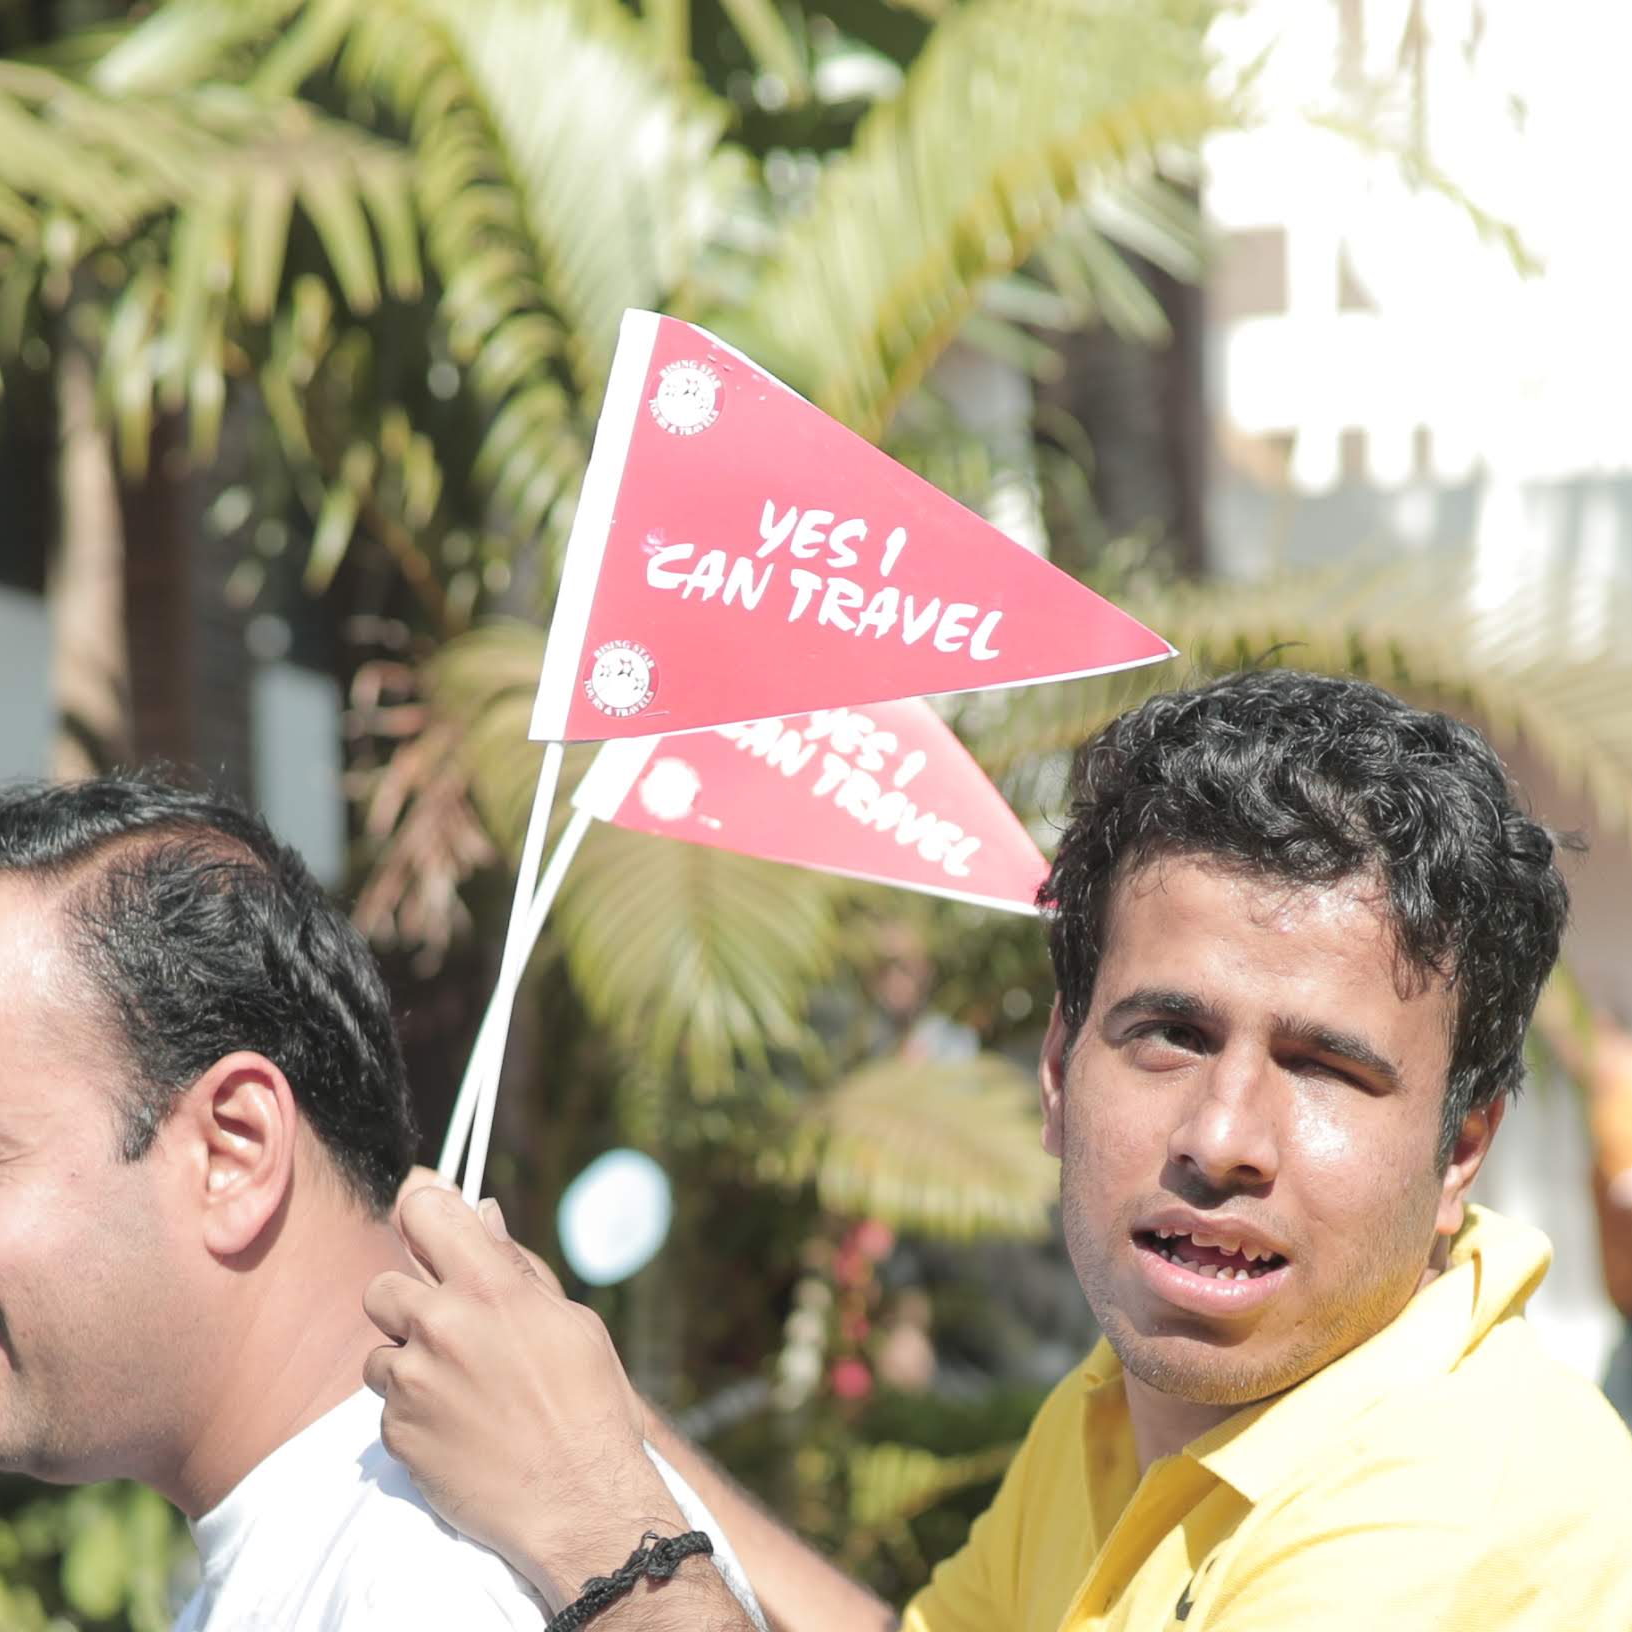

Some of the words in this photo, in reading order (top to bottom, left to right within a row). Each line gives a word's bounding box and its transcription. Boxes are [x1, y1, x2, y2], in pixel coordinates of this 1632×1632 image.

[699, 363, 722, 389] STAR
[679, 410, 720, 435] TRAVELS
[755, 499, 868, 568] YES
[879, 526, 907, 577] I
[646, 543, 774, 611] CAN
[787, 568, 1003, 661] TRAVEL
[593, 639, 631, 659] RISING
[633, 643, 655, 669] STAR
[583, 679, 604, 711] TOURS
[615, 690, 655, 718] TRAVELS
[802, 707, 898, 772] YES
[893, 749, 927, 788] I
[812, 752, 982, 877] TRAVEL
